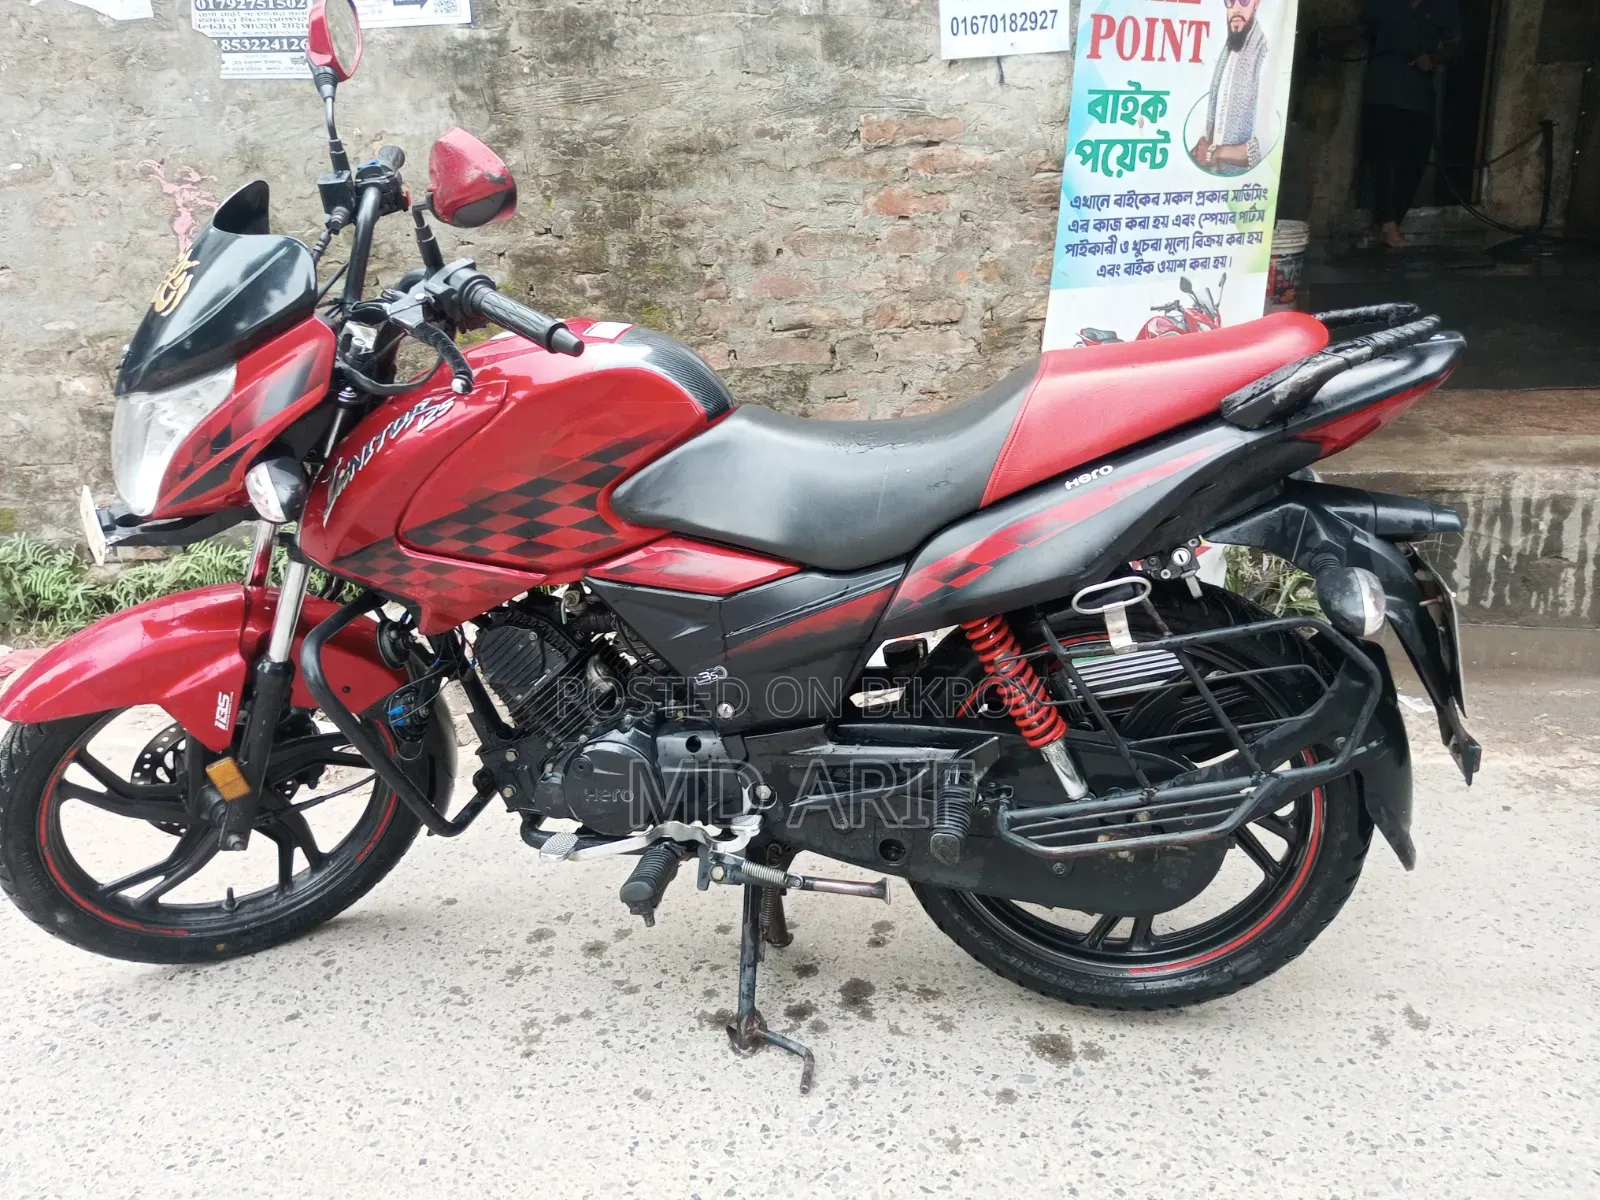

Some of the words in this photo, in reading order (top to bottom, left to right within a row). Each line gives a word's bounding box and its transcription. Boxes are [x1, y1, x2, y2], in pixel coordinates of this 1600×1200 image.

[950, 9, 1058, 36] 01670182927
[1086, 13, 1211, 64] POINT
[1087, 80, 1171, 126] বাইক
[1074, 129, 1171, 178] পয়েন্ট
[1070, 194, 1111, 212] এখানে
[1113, 189, 1161, 210] বাইকের
[1162, 191, 1194, 205] সকল
[1195, 189, 1230, 206] প্রকার
[1068, 219, 1090, 233] এর
[1093, 217, 1123, 232] কাজ
[1125, 216, 1150, 230] করা
[1152, 215, 1170, 229] হয়
[1172, 213, 1196, 227] এবং
[1064, 234, 1118, 257] পাইকারী
[1120, 240, 1130, 254] ও
[1132, 238, 1163, 258] খুচরা
[1191, 230, 1224, 249] বিক্রয়
[1226, 232, 1246, 246] করা
[1246, 231, 1264, 245] হয়
[1096, 263, 1122, 278] এবং
[1123, 258, 1155, 276] বাইক
[1157, 259, 1188, 273] ওয়াশ
[1189, 256, 1212, 270] করা
